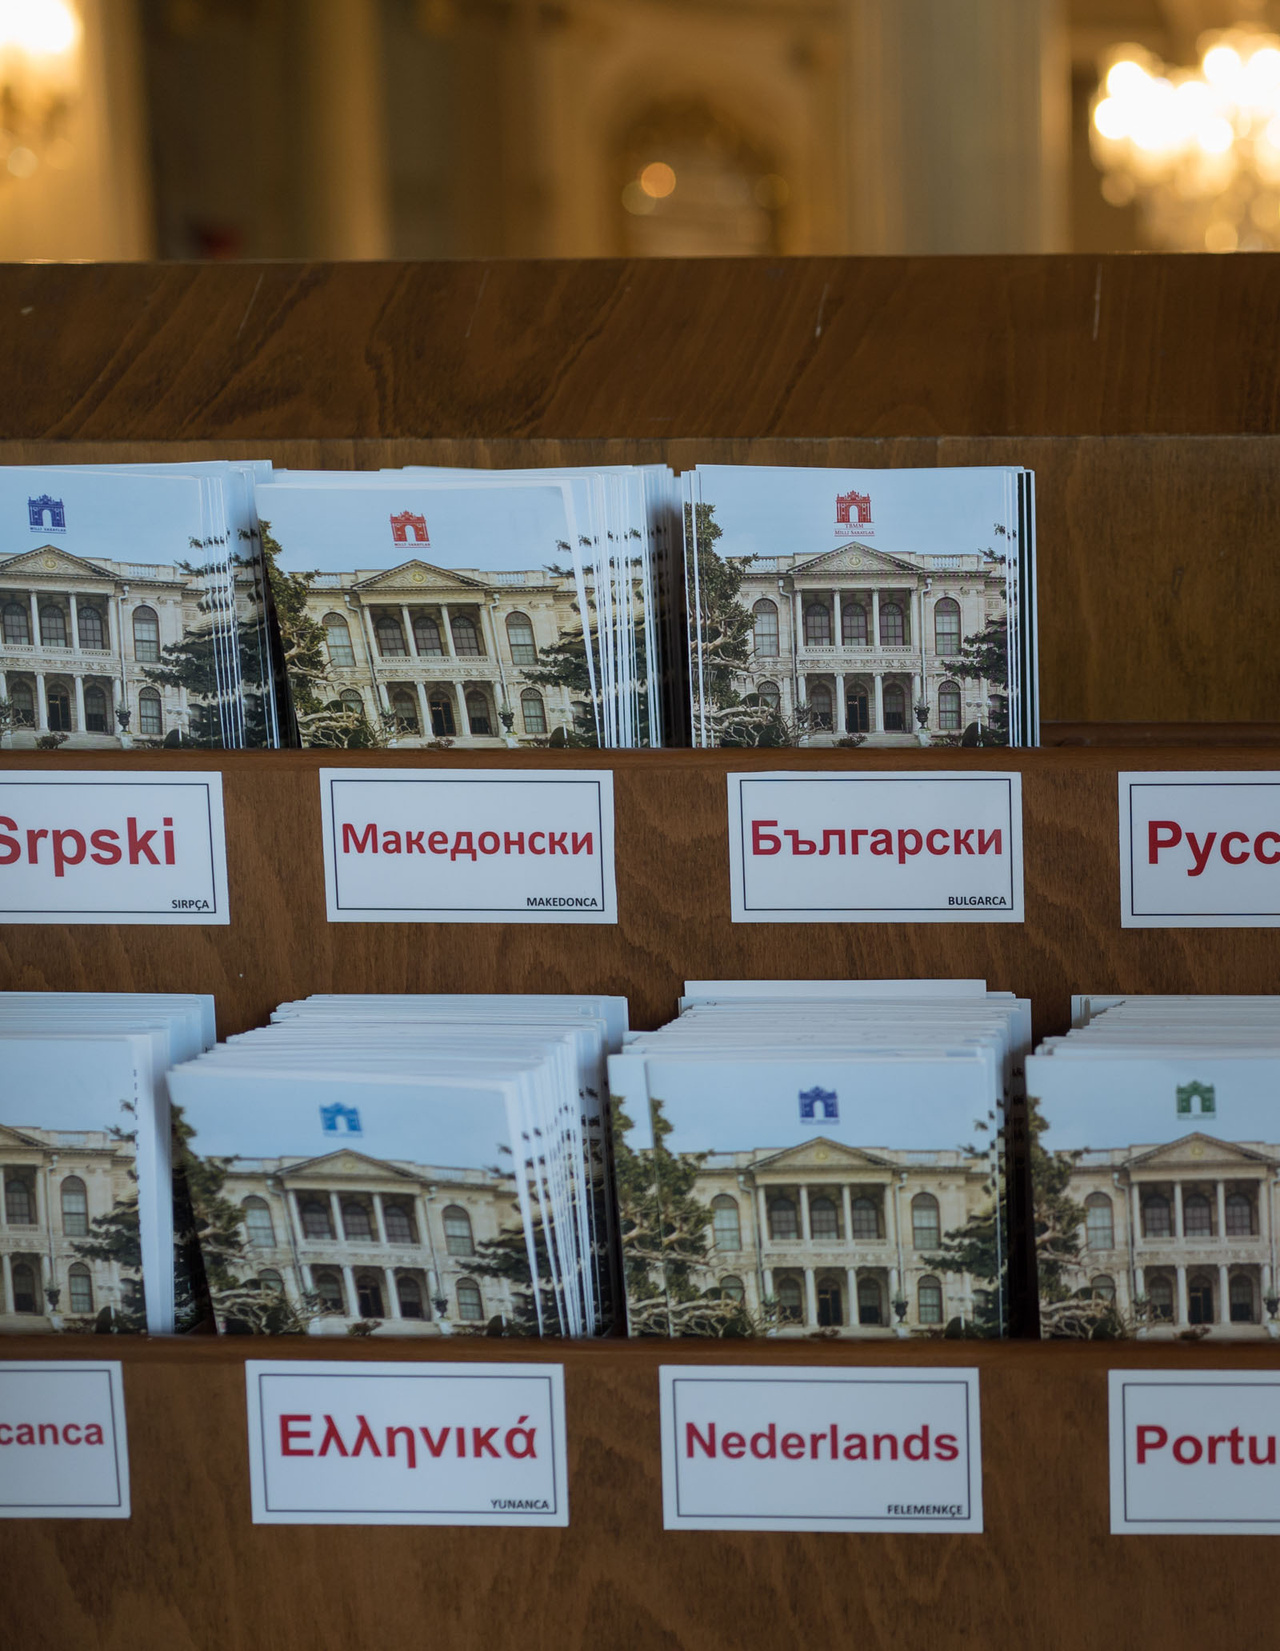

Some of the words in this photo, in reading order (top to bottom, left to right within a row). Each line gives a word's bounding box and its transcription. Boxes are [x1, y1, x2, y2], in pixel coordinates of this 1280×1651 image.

[0, 815, 176, 878] Srpski
[342, 823, 595, 863] Македонски
[751, 819, 1003, 865] Български
[171, 899, 210, 911] SIRPÇA
[526, 897, 599, 908] MAKEDONCA
[948, 896, 1007, 906] BULGARCA
[279, 1414, 538, 1470] Ελληνικά
[685, 1422, 960, 1462] Nederlands
[490, 1499, 550, 1510] YUNANCA
[887, 1504, 964, 1518] FELEMENKÇE
